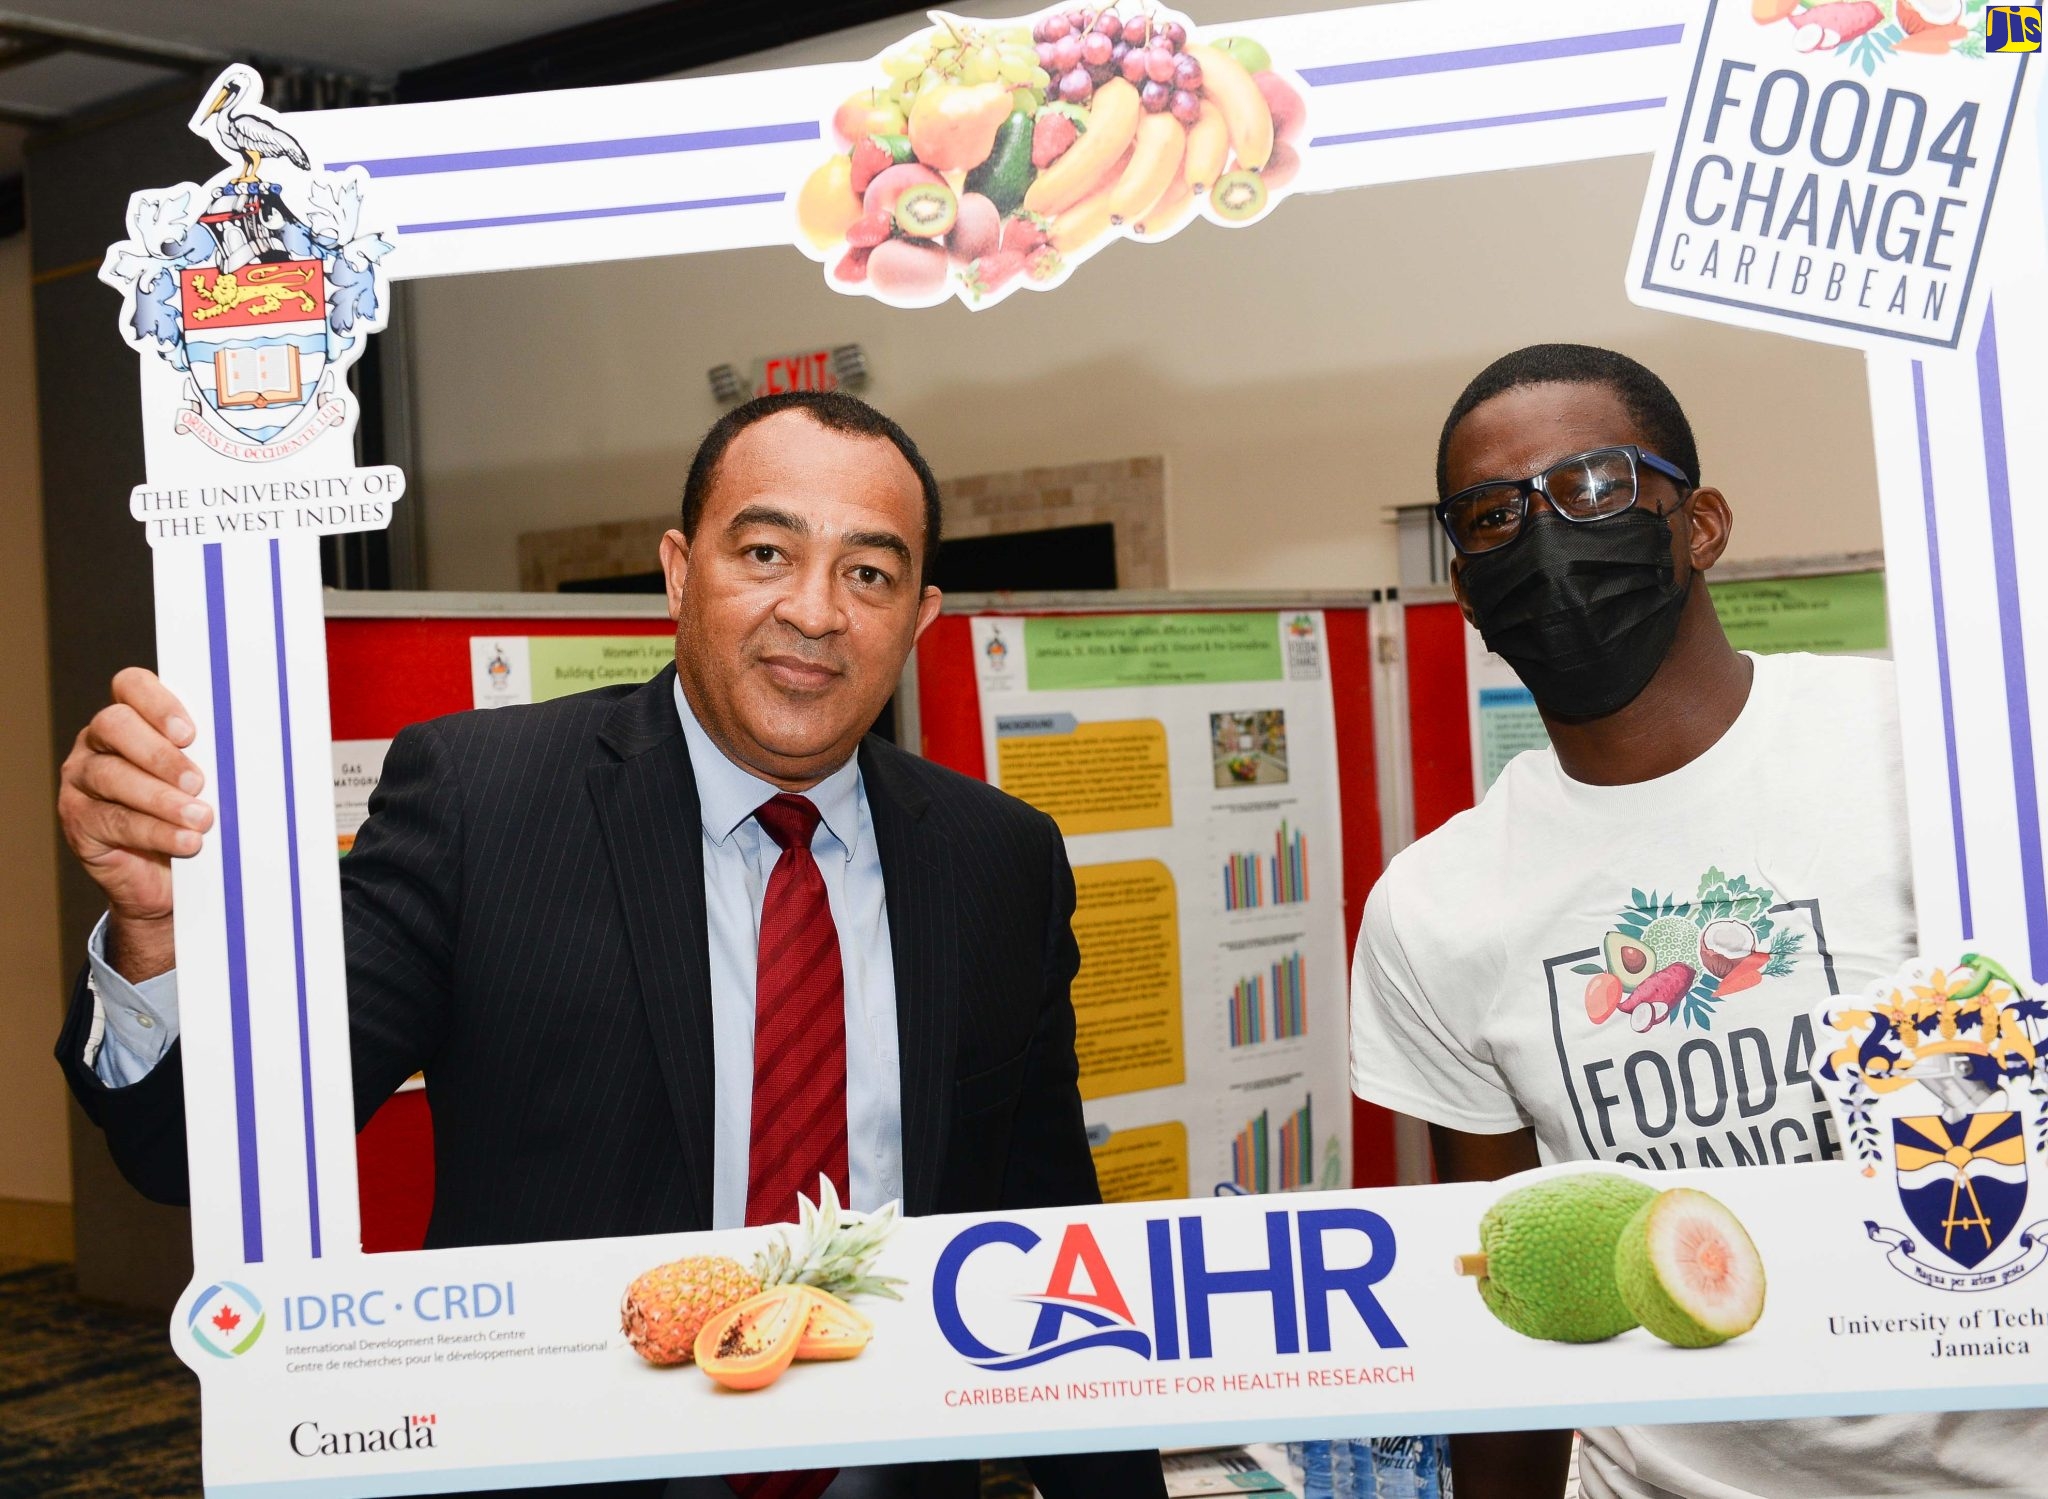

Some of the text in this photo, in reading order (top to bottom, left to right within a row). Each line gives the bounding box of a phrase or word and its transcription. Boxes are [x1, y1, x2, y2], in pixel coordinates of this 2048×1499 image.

[1703, 59, 1980, 188] FOOD4
[1686, 155, 1967, 271] CHANGE
[1670, 233, 1948, 321] CARIBBEAN
[136, 474, 398, 511] THE UNIVERSITY OF
[153, 502, 385, 538] THE WEST INDIES
[1583, 1013, 1830, 1147] FOOD4
[284, 1290, 386, 1331] IDRC
[414, 1281, 515, 1321] CRDI
[932, 1208, 1409, 1371] CAIHR
[286, 1329, 526, 1355] International Development Research Centre
[1828, 1308, 2048, 1336] University of Tech
[286, 1341, 608, 1374] Centre de recherches pour le développement international
[1931, 1337, 2030, 1358] Jamaica
[944, 1366, 1415, 1407] CARIBBEAN INSTITUTE FOR HEALTH RESEARCH
[289, 1416, 437, 1457] Canada
